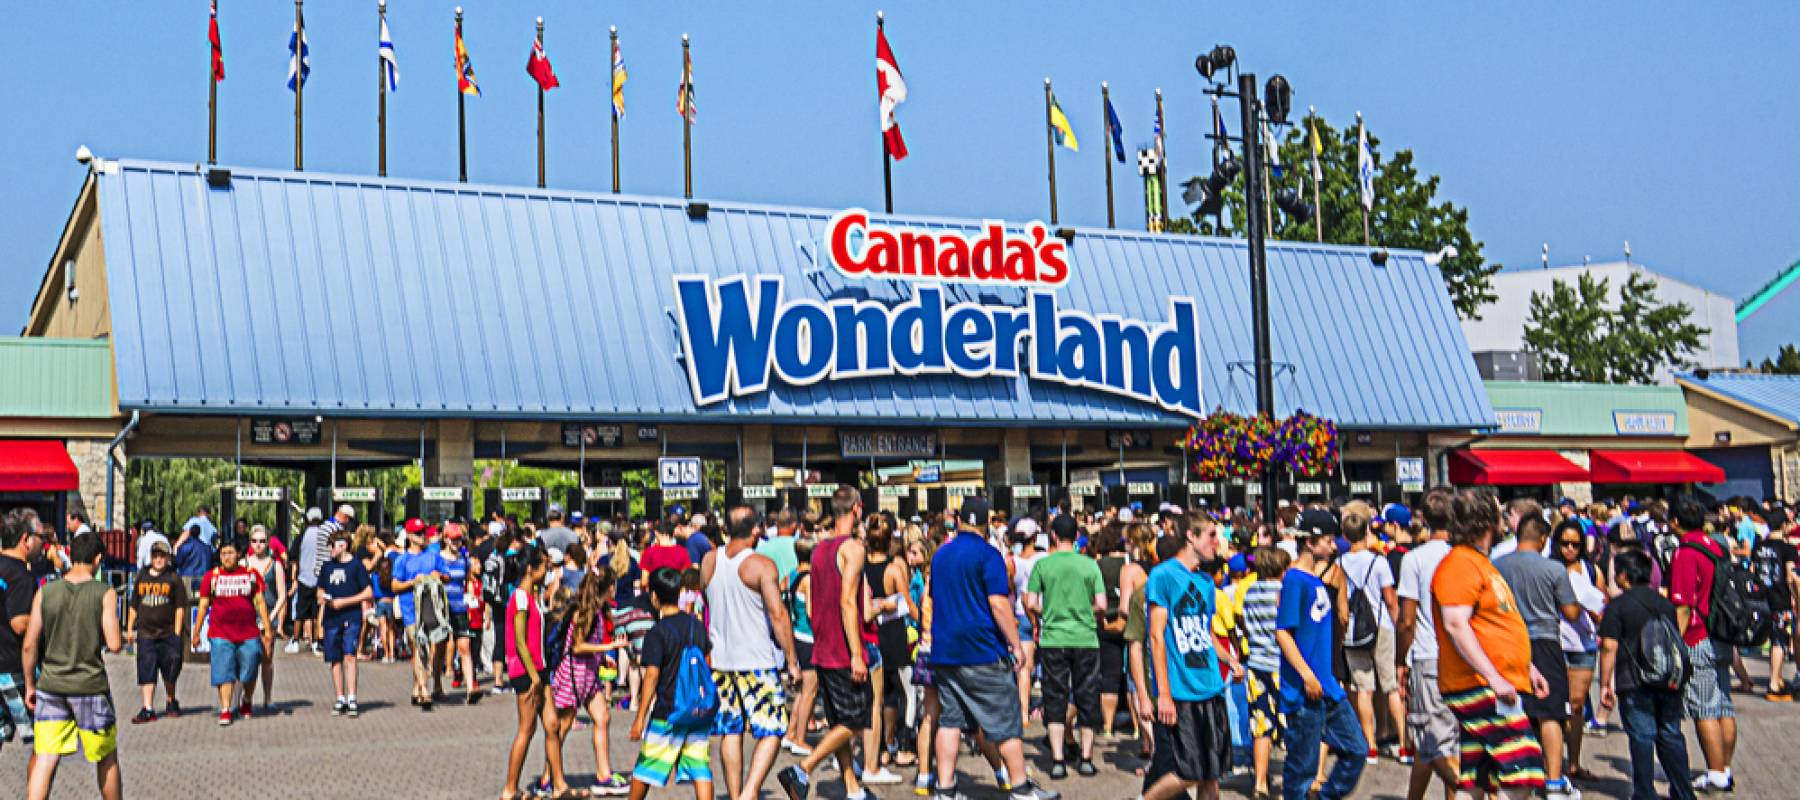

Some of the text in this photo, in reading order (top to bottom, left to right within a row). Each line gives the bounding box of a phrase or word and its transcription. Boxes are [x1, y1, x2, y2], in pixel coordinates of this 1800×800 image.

[830, 213, 1069, 282] Canada's
[677, 278, 1203, 416] Wonderland
[842, 434, 935, 454] PARK ENTRANCE
[240, 488, 274, 497] OPEN
[592, 489, 616, 497] OPEN
[665, 489, 693, 498] OPEN
[746, 488, 772, 496] OPEN
